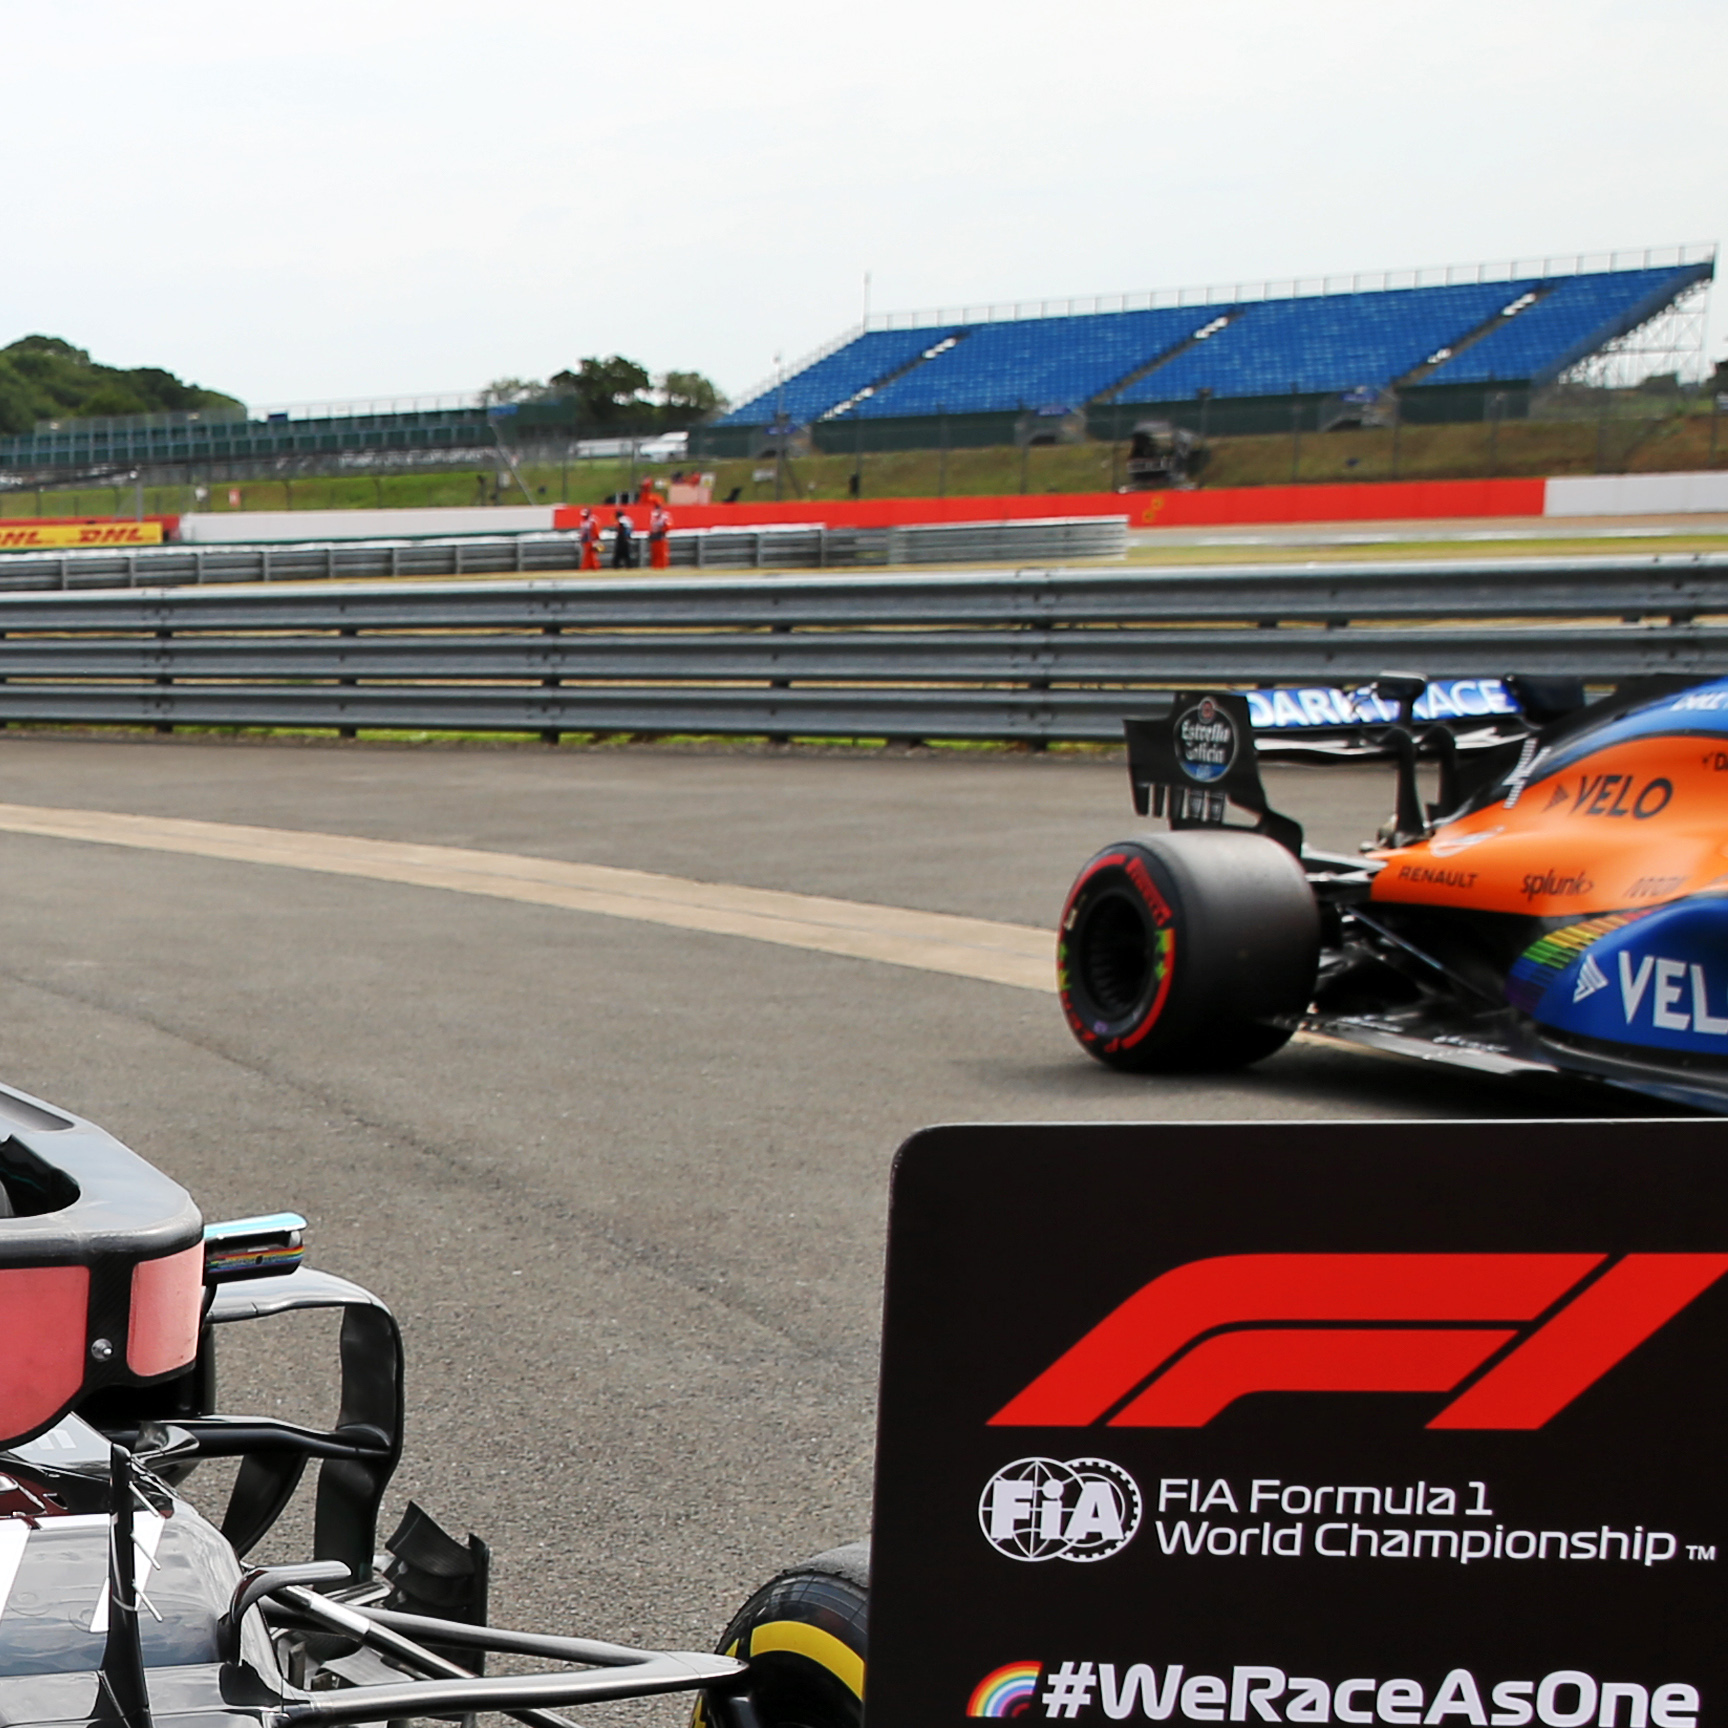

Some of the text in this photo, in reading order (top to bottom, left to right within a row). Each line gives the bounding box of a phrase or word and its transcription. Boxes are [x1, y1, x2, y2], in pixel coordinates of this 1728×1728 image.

[79, 528, 141, 543] DHL
[1247, 679, 1517, 728] DARKTACE
[1567, 774, 1674, 819] VELO
[1399, 865, 1479, 888] RENAULT
[1618, 950, 1728, 1036] VEL
[1157, 1478, 1494, 1516] FIA Formula 1
[1154, 1520, 1303, 1557] World
[1315, 1522, 1677, 1567] Championship
